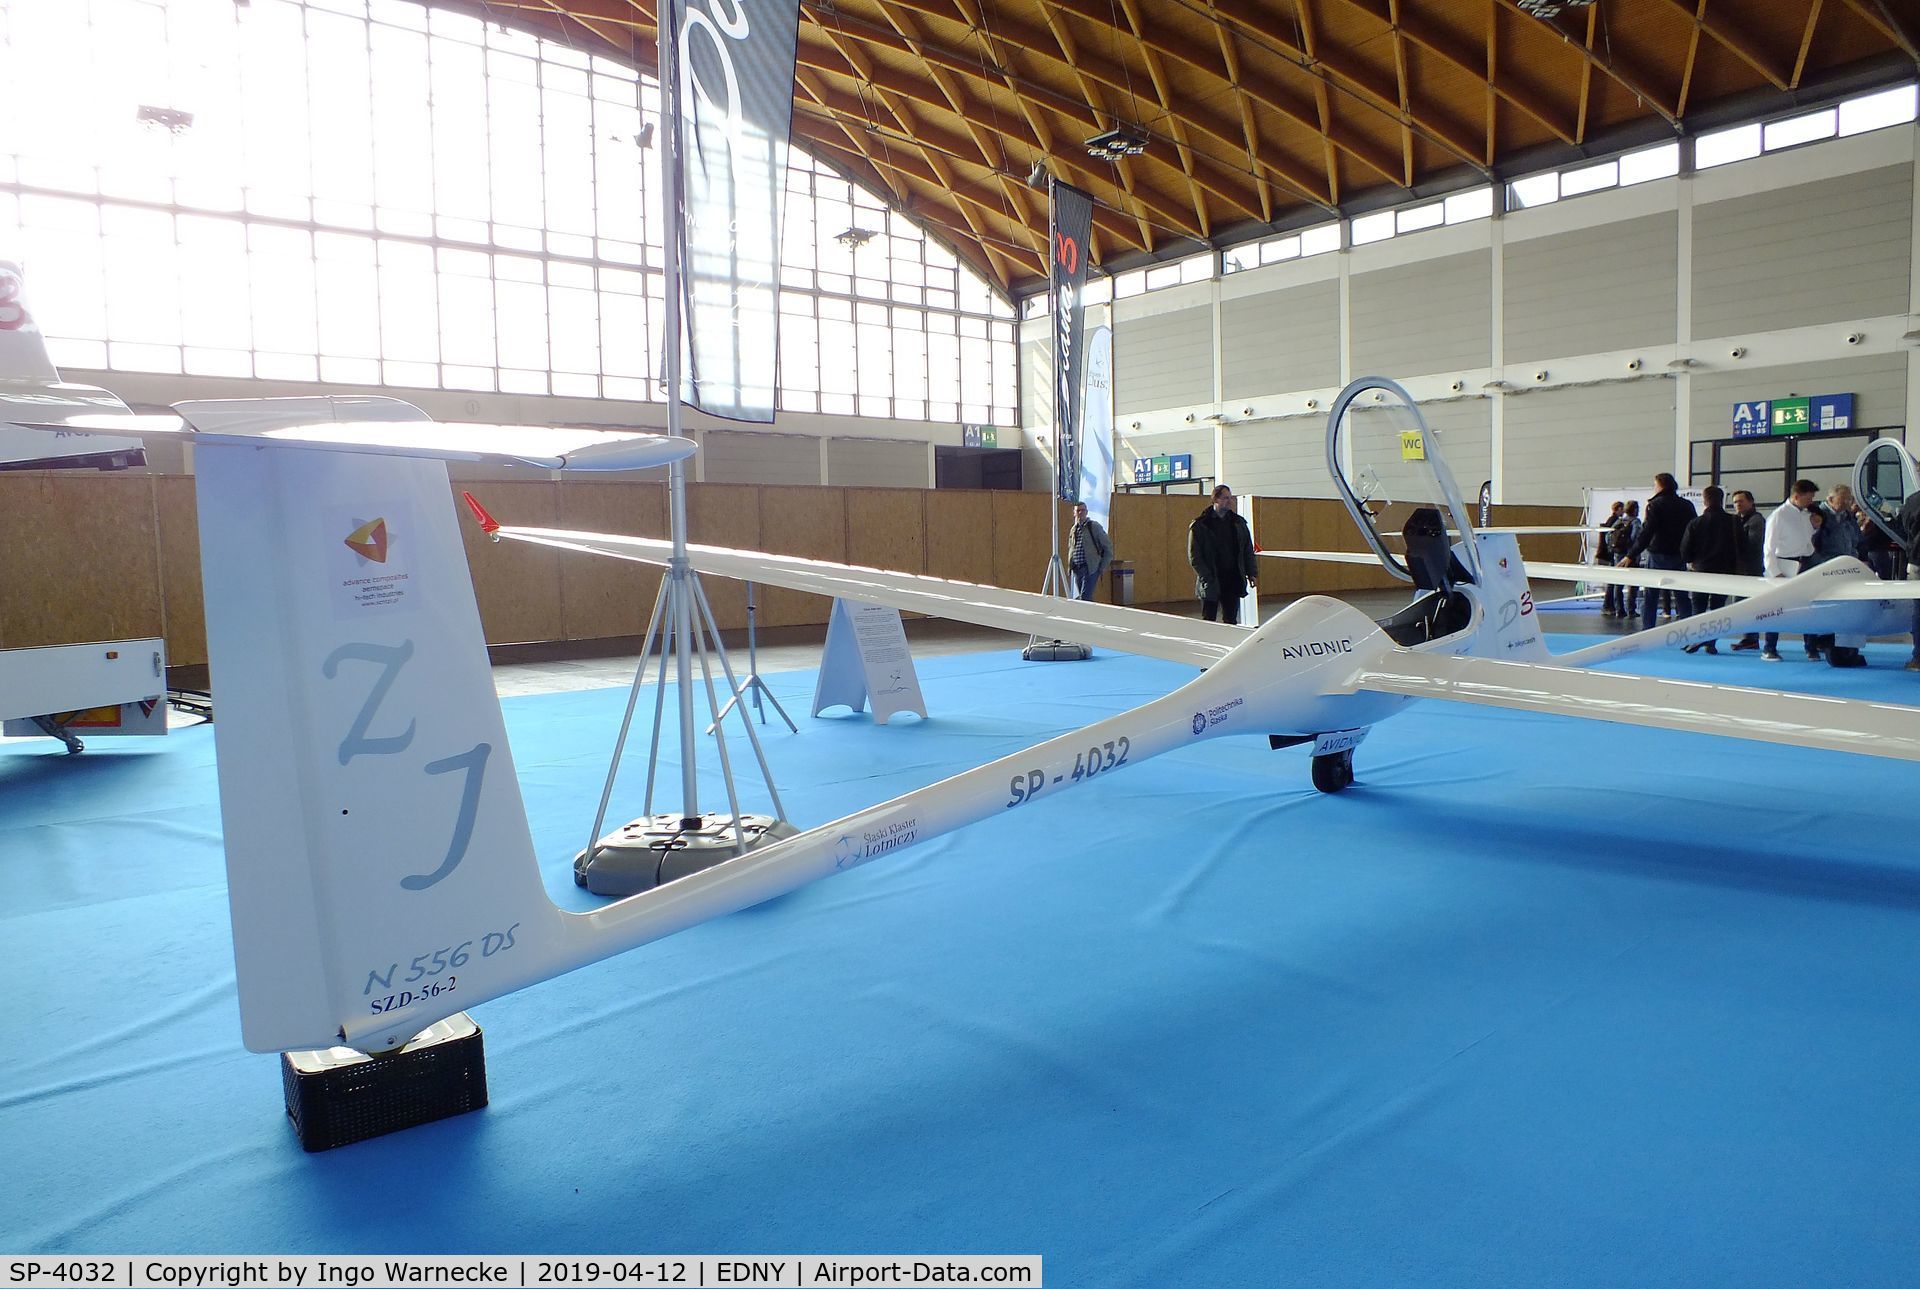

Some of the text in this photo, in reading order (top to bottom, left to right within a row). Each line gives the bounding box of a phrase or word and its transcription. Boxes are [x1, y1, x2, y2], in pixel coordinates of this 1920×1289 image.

[1733, 401, 1767, 422] A1
[966, 426, 980, 438] A1
[1403, 438, 1421, 449] WC
[1135, 458, 1151, 473] A1
[1666, 617, 1732, 646] OK-5513
[1282, 639, 1352, 660] AVIONIC
[322, 638, 416, 766] Z
[1007, 768, 1045, 808] SP
[1071, 736, 1130, 782] 4032
[888, 818, 916, 835] Klaster
[865, 829, 918, 858] Lotniczy
[371, 976, 456, 1015] SZD-56-2
